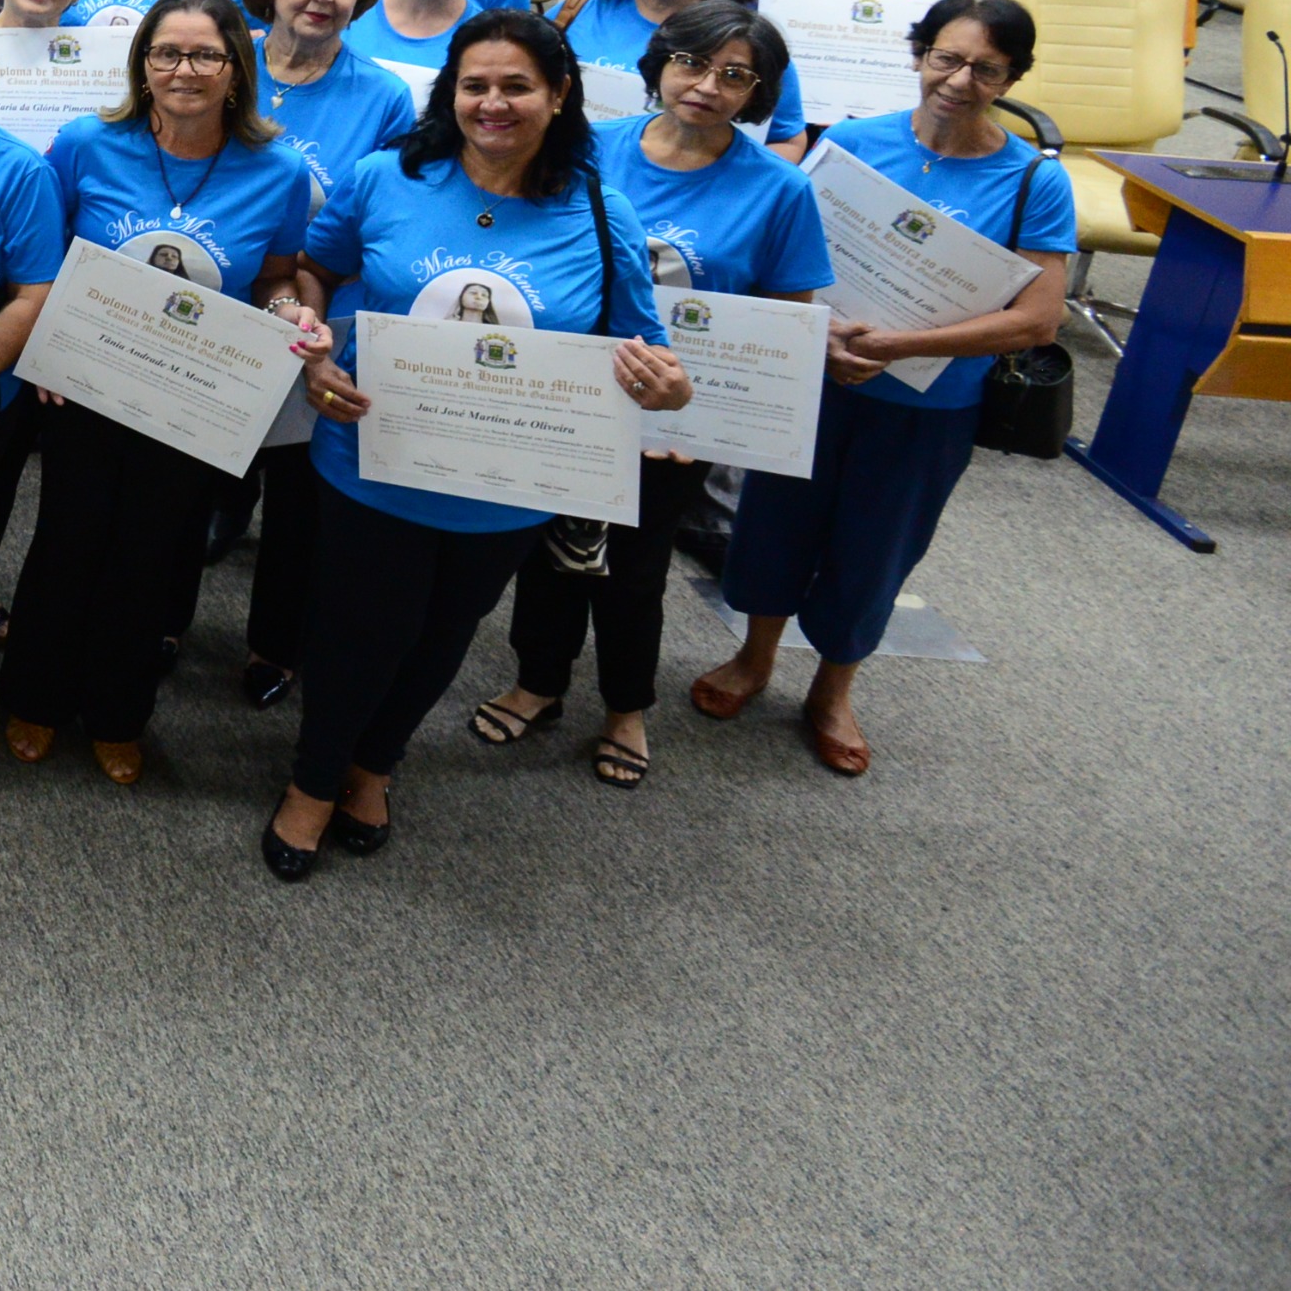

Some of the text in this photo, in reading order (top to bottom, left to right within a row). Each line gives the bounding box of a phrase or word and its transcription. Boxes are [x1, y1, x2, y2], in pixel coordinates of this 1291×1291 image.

[36, 67, 47, 77] de
[52, 67, 87, 78] Honra
[91, 70, 104, 78] ao
[19, 104, 30, 112] da
[33, 104, 60, 112] Glória
[106, 211, 161, 245] Mães
[819, 188, 865, 224] Diploma
[867, 216, 881, 233] de
[883, 231, 921, 260] Honra
[938, 266, 979, 294] Mérito
[411, 247, 472, 283] Mães
[875, 270, 916, 300] Carvalho
[86, 286, 264, 370] Diploma de Honra ao Mérito
[98, 333, 218, 391] Tânia Andrade M. Morais
[671, 331, 790, 360] Honra ao Mérito
[393, 358, 603, 398] Diploma de Honra ao Mérito
[693, 375, 751, 393] R. da Silva
[415, 402, 576, 435] Jaci José Martins de Oliveira
